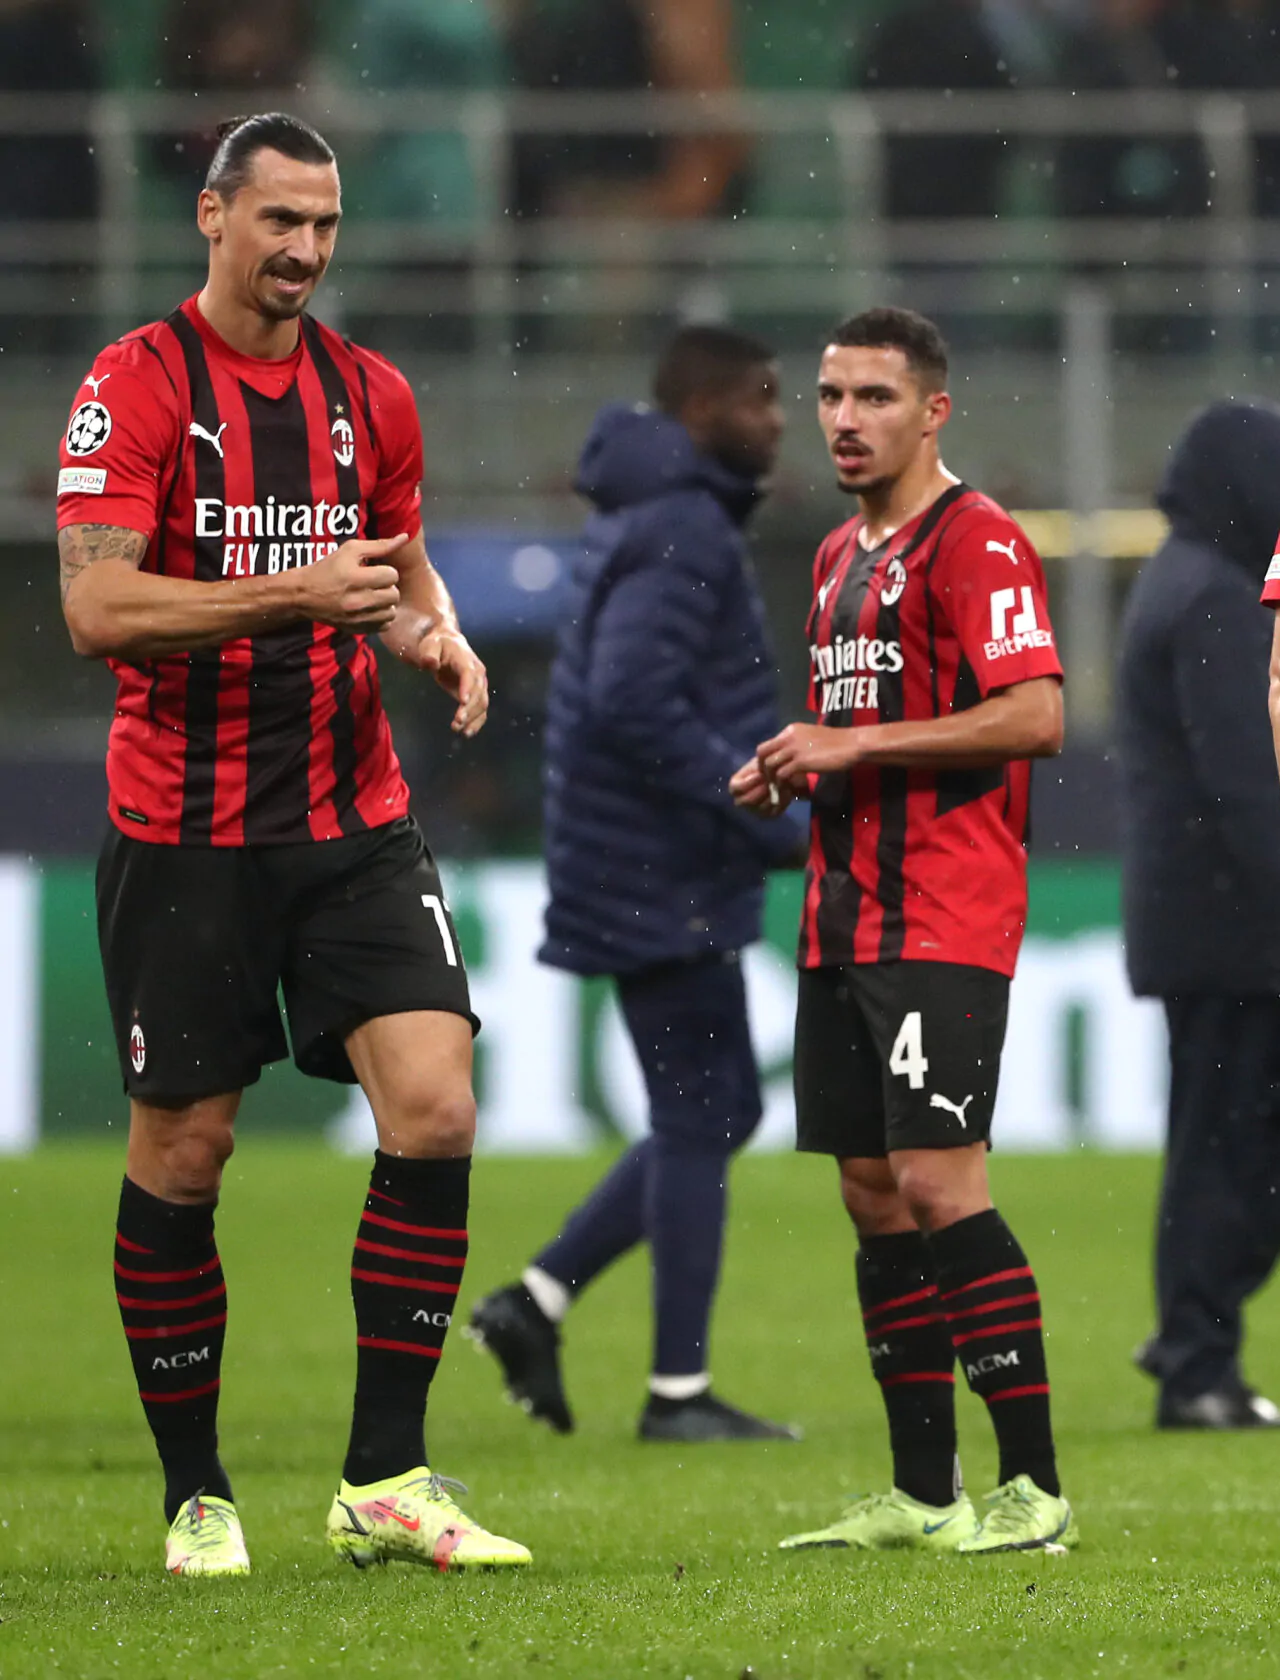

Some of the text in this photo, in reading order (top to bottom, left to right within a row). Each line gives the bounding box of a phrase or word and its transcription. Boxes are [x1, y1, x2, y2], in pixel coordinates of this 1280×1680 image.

[194, 496, 359, 537] Emirates
[222, 543, 260, 576] FLY
[421, 894, 465, 970] 1
[889, 1011, 929, 1090] 4
[152, 1346, 209, 1370] ACM
[966, 1350, 1020, 1380] ACM
